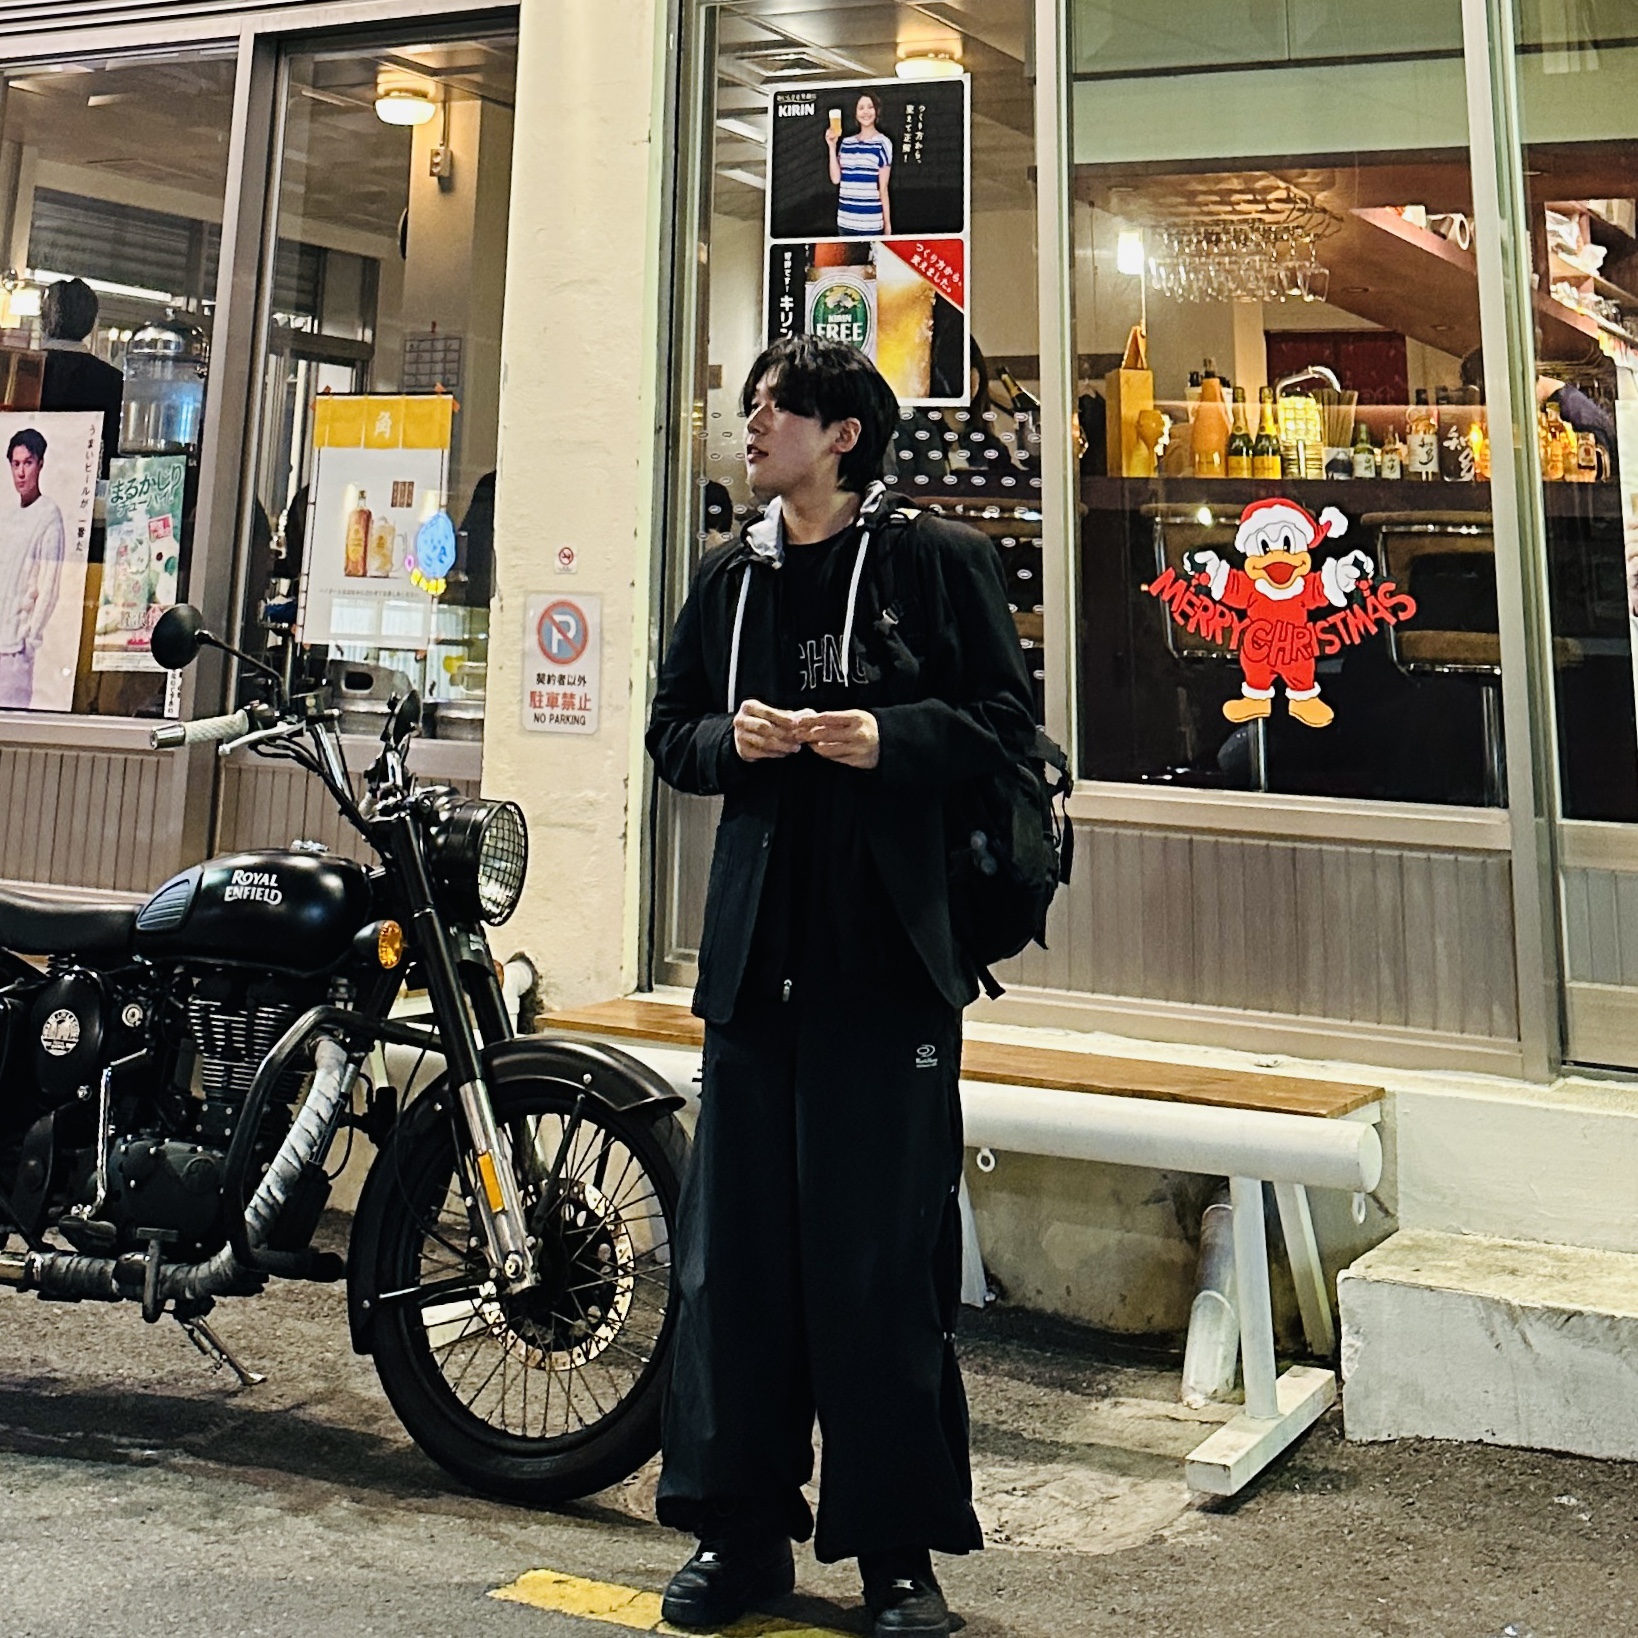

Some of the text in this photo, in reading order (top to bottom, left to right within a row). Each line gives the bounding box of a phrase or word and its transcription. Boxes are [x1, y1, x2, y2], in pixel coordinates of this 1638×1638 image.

[778, 103, 815, 117] KIRIN
[828, 314, 852, 322] KIRIN
[816, 322, 863, 341] FREE
[374, 410, 393, 439] 角
[111, 464, 182, 504] まるかじり
[1148, 567, 1417, 667] MERRY CHRISTMAS
[536, 673, 587, 687] 契約者以外
[529, 690, 592, 712] 駐車禁止
[533, 713, 587, 726] NO PARKING
[232, 870, 278, 887] ROYAL
[224, 886, 283, 906] ENFIELD
